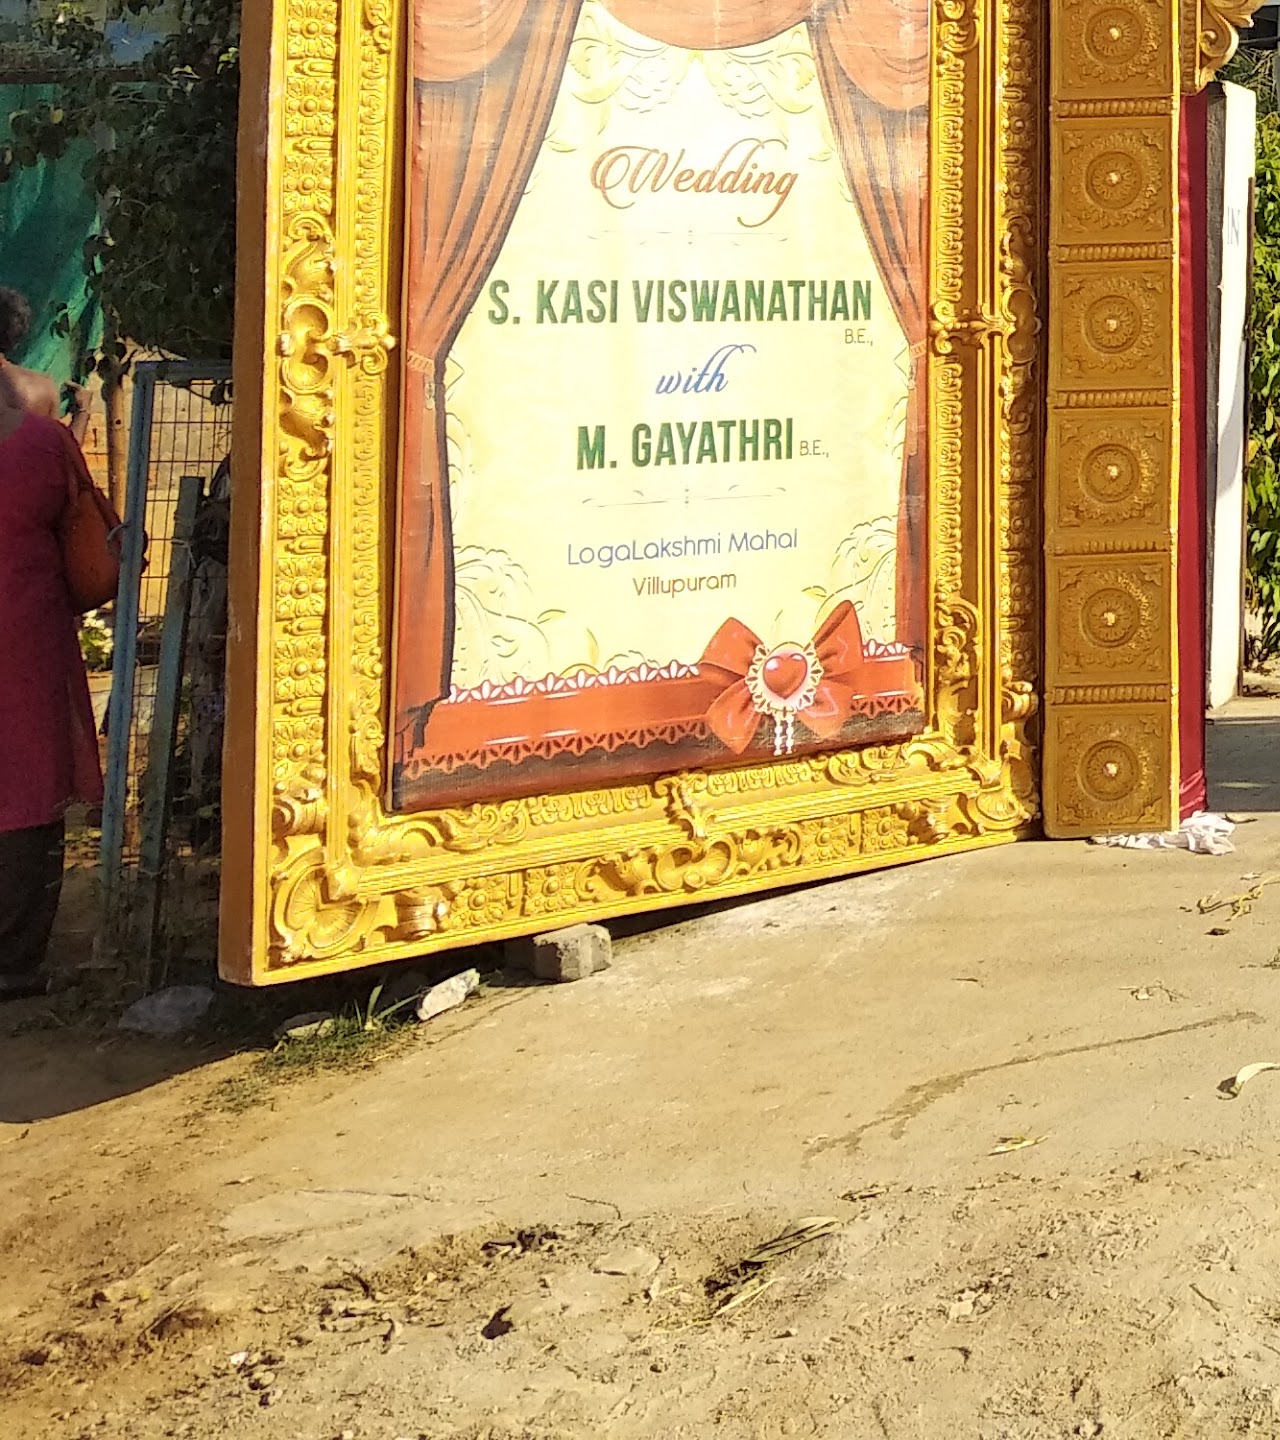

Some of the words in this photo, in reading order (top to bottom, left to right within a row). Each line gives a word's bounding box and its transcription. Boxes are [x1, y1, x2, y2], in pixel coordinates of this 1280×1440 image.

[590, 138, 798, 227] Wedding
[488, 280, 520, 324] S.
[536, 280, 618, 324] KASI
[632, 279, 872, 323] VISWANATHAN
[655, 344, 757, 394] with
[577, 425, 617, 470] M.
[631, 418, 793, 468] GAYATHRI
[567, 533, 721, 568] LogaLakshmi
[728, 528, 798, 553] Mahal
[632, 573, 737, 598] Villupuram
